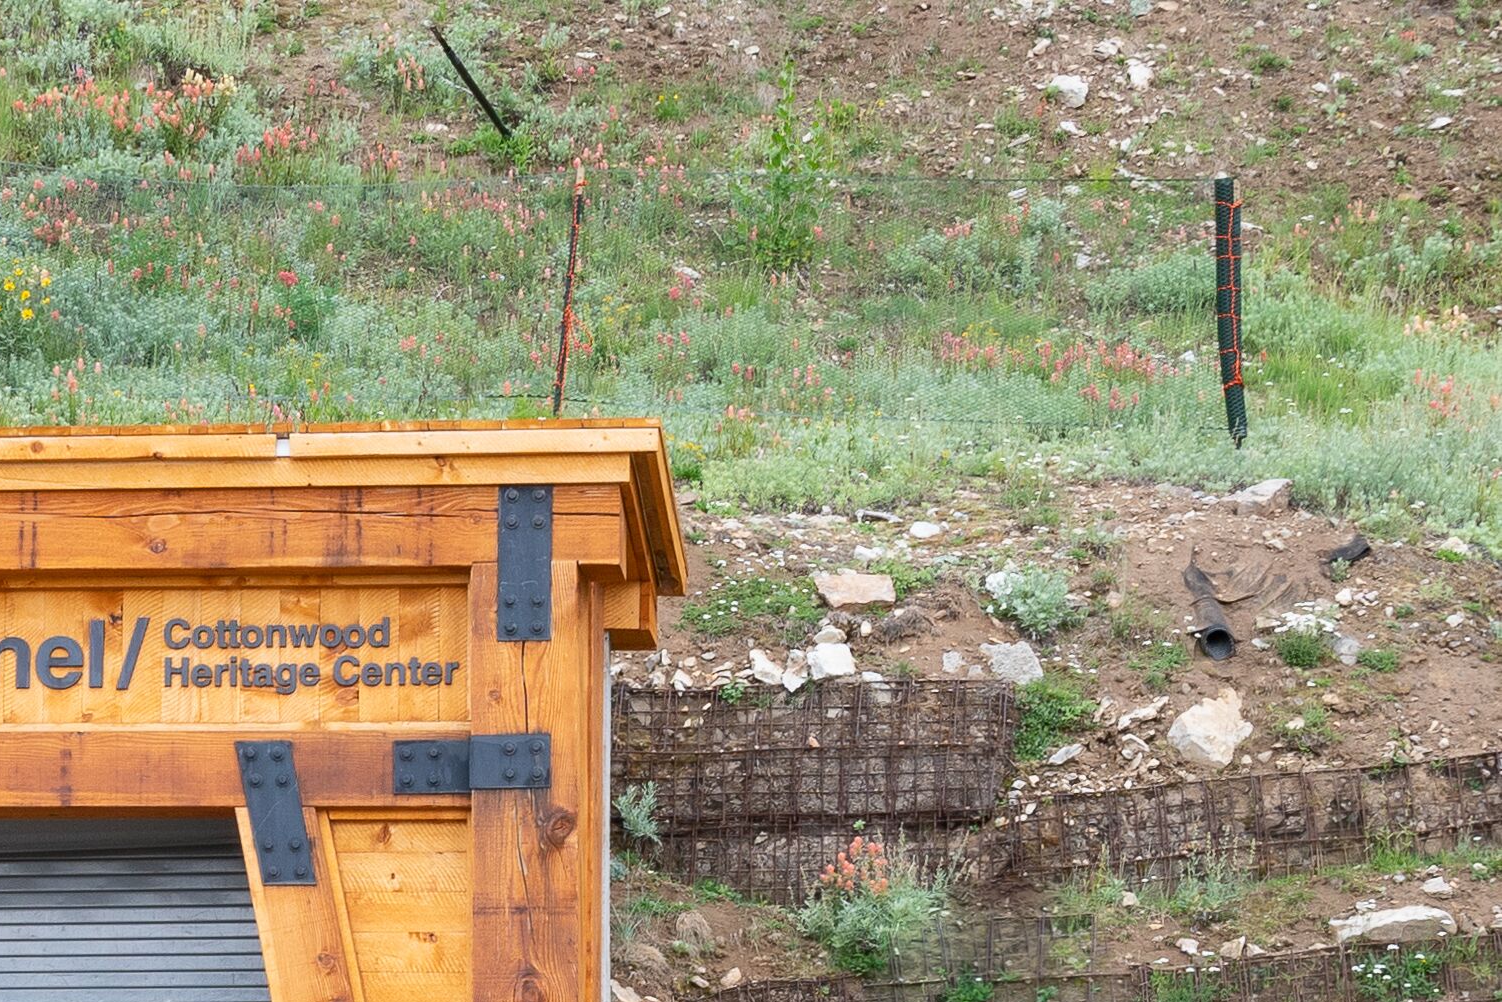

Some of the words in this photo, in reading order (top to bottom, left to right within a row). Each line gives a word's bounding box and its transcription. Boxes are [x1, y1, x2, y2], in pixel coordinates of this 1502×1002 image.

[163, 618, 390, 649] Cottonwood
[164, 655, 320, 695] Heritage
[332, 656, 459, 687] Center
